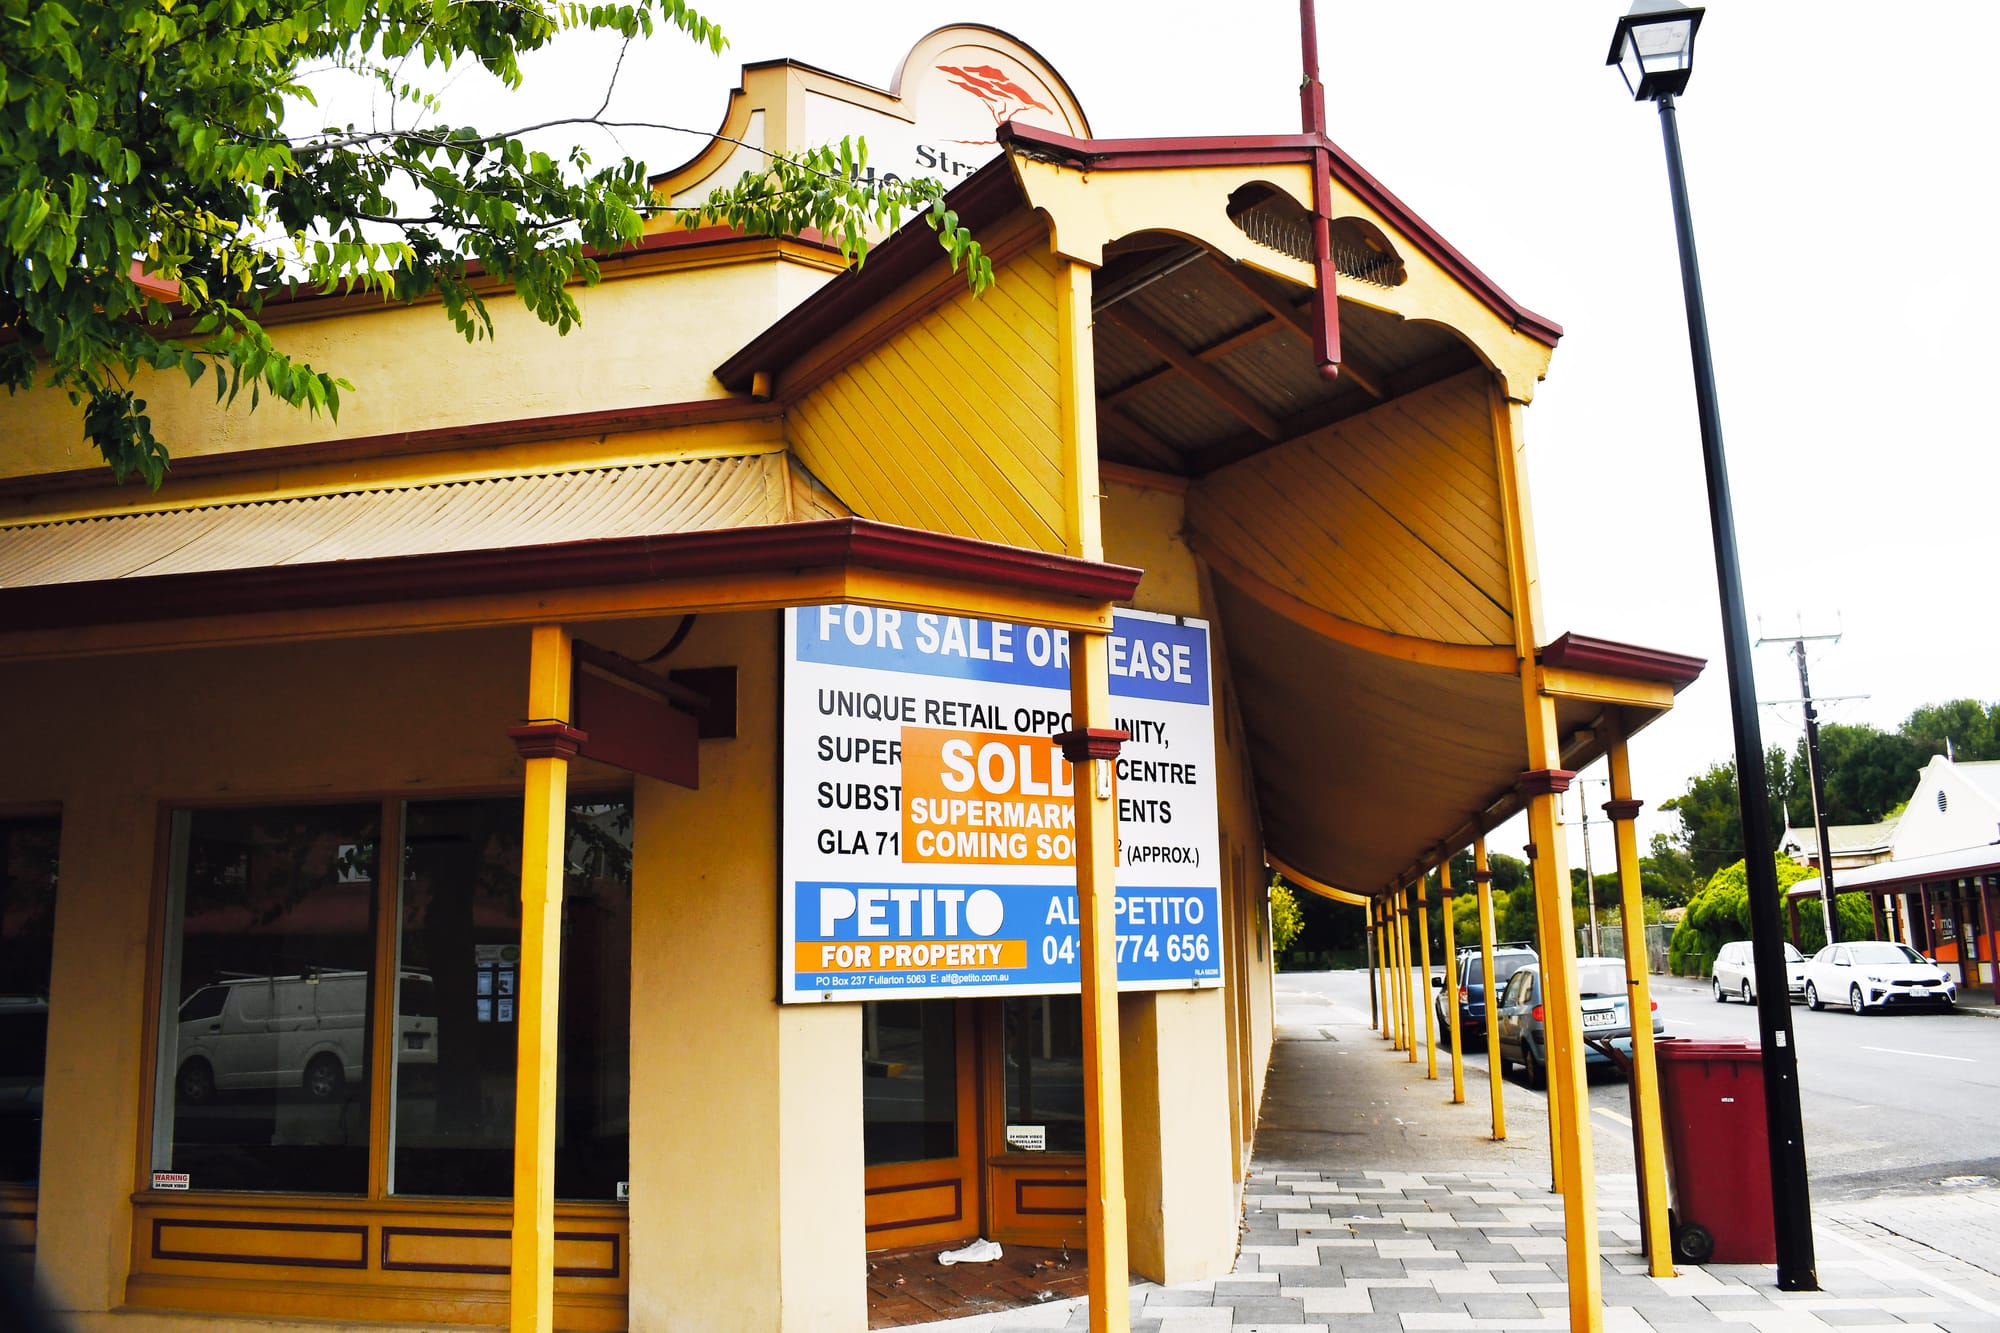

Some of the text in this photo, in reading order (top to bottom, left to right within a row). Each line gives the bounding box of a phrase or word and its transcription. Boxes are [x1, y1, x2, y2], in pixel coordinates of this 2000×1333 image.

[819, 605, 903, 650] FOR
[915, 613, 1015, 663] SALE
[1108, 635, 1192, 685] EASE
[818, 688, 917, 722] UNIQUE
[925, 699, 1008, 731] RETAIL
[1116, 759, 1197, 785] CENTRE
[910, 797, 1077, 829] SUPERMARK
[1118, 798, 1173, 824] ENTS
[817, 828, 869, 855] GLA
[1127, 845, 1200, 868] (APPROX.)
[915, 830, 1028, 859] COMING
[820, 887, 1004, 938] PETITO
[1045, 895, 1205, 925] AL PETITO
[821, 943, 1004, 968] FOR PROPERTY
[1116, 934, 1160, 963] 774
[1166, 933, 1211, 963] 656
[816, 973, 1009, 986] PO Box 237 Fullarton 5063 E: alf@petito.com.au
